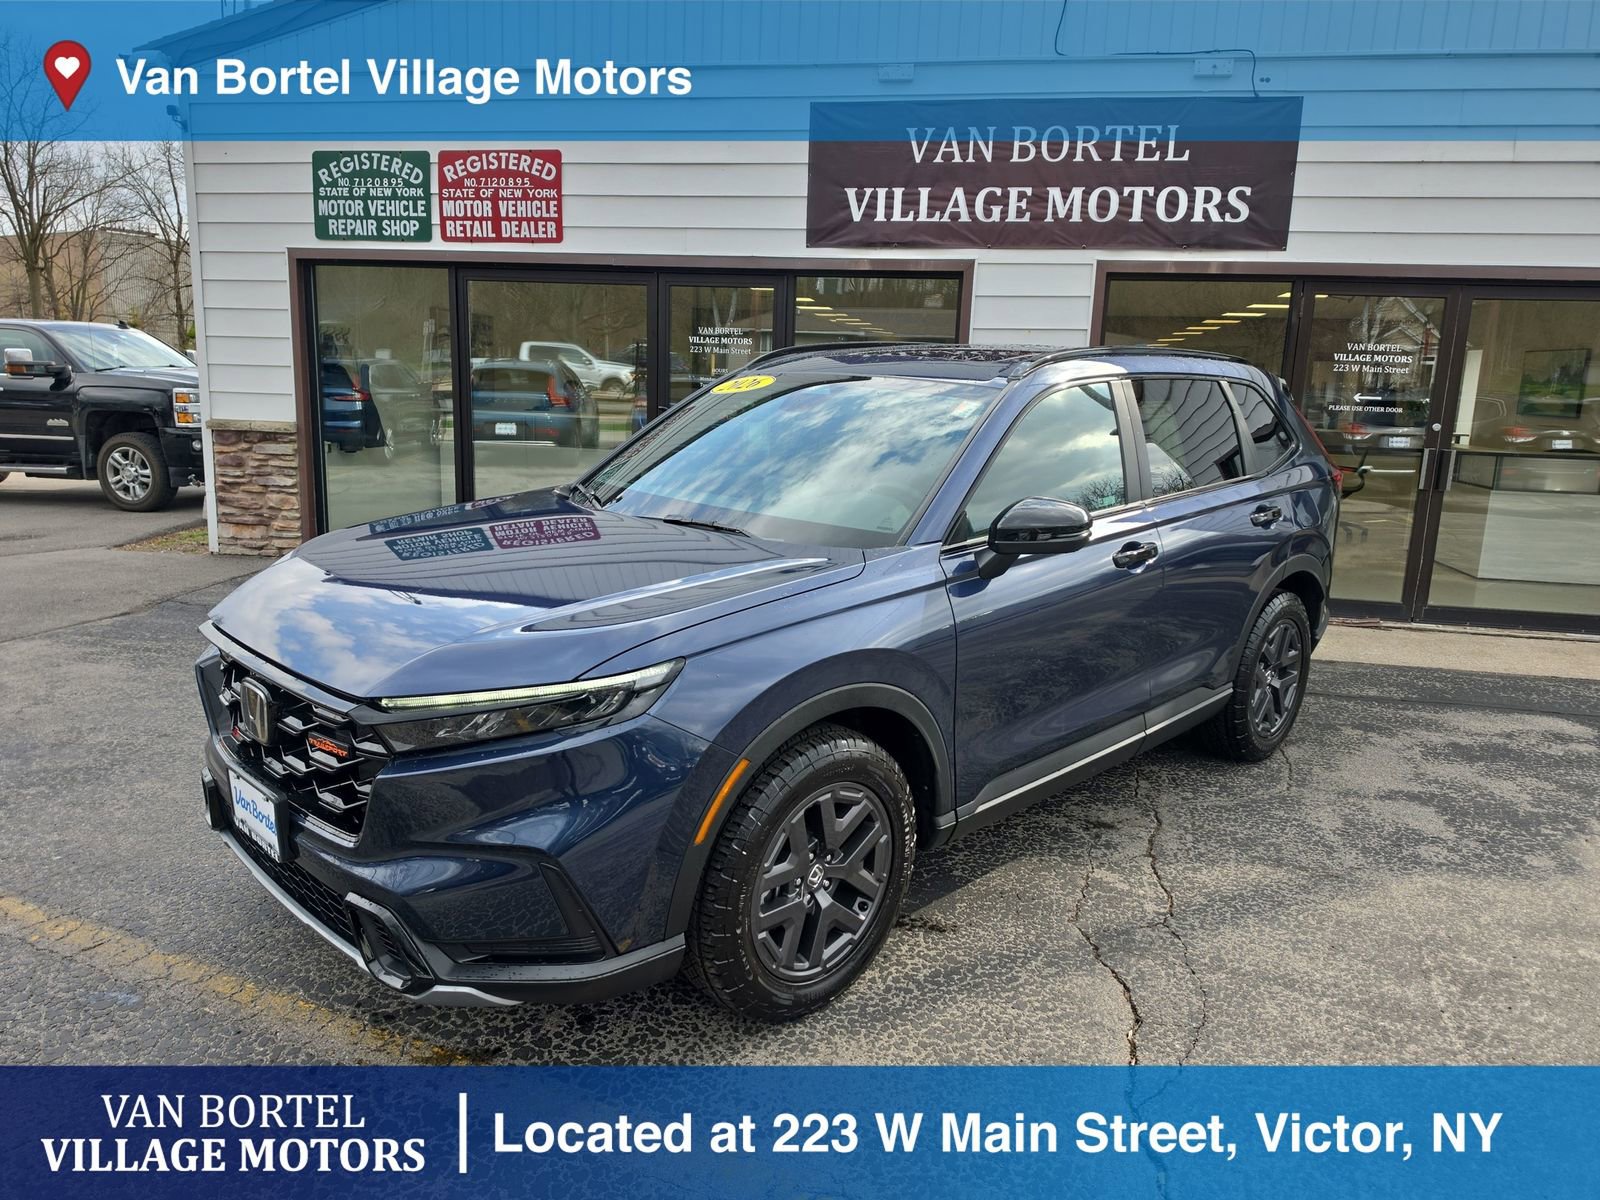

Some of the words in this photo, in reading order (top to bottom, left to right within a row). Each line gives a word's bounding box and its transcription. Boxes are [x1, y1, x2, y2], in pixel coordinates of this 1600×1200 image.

[907, 126, 993, 163] VAN
[1010, 124, 1190, 163] BORTEL
[317, 152, 424, 185] REGISTERED
[442, 152, 557, 183] REGISTERED
[337, 178, 351, 187] NO.
[353, 177, 404, 187] 7120895
[464, 178, 478, 188] NO.
[480, 177, 531, 187] 7120895
[319, 187, 349, 197] STATE
[353, 188, 366, 197] OF
[369, 187, 392, 197] NEW
[396, 187, 424, 197] YORK
[442, 188, 474, 198] STATE
[480, 188, 494, 198] OF
[499, 188, 523, 198] NEW
[526, 188, 558, 198] YORK
[319, 200, 364, 217] MOTOR
[368, 200, 427, 217] VEHICLE
[442, 200, 493, 218] MOTOR
[499, 200, 558, 218] VEHICLE
[844, 187, 1032, 223] VILLAGE
[1045, 186, 1252, 223] MOTORS
[328, 219, 377, 236] REPAIR
[382, 219, 420, 236] SHOP
[446, 220, 496, 238] RETAIL
[501, 220, 557, 238] DEALER
[698, 327, 713, 335] VAN
[714, 327, 743, 335] BORTEL
[688, 336, 720, 344] VILLAGE
[721, 337, 753, 345] MOTORS
[712, 346, 730, 354] Main
[731, 347, 752, 355] Street
[1347, 343, 1365, 351] VAN
[1367, 343, 1402, 352] BORTEL
[1333, 353, 1372, 362] VILLAGE
[1373, 354, 1413, 364] MOTORS
[1333, 363, 1350, 372] 223
[1351, 364, 1361, 372] W
[1362, 364, 1383, 373] Main
[1384, 365, 1410, 374] Street
